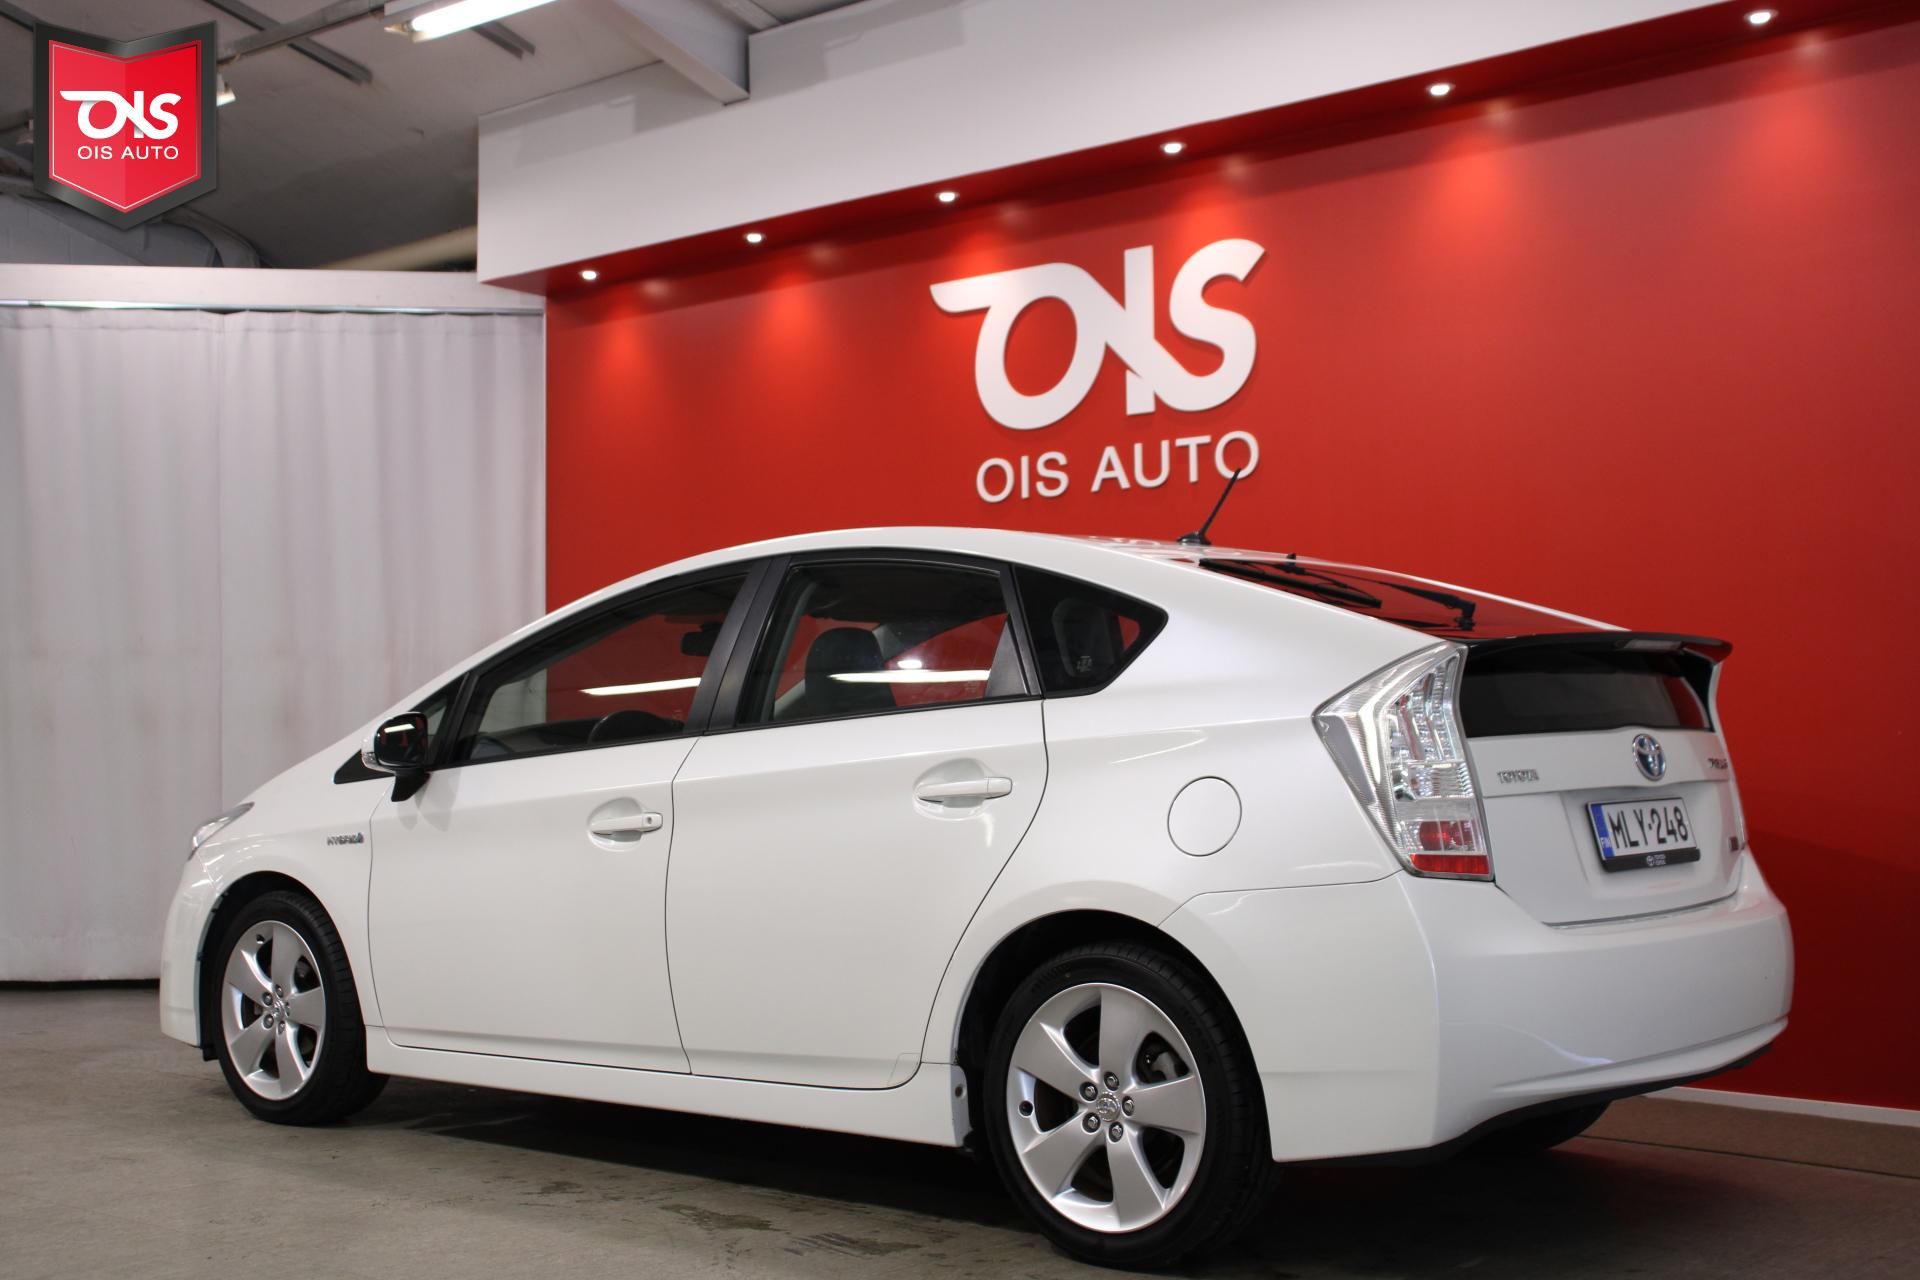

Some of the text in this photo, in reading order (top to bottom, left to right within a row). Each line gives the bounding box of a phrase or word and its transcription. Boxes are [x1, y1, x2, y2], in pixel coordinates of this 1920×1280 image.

[976, 430, 1259, 503] OIS AUTO
[1607, 805, 1688, 848] MLY-248
